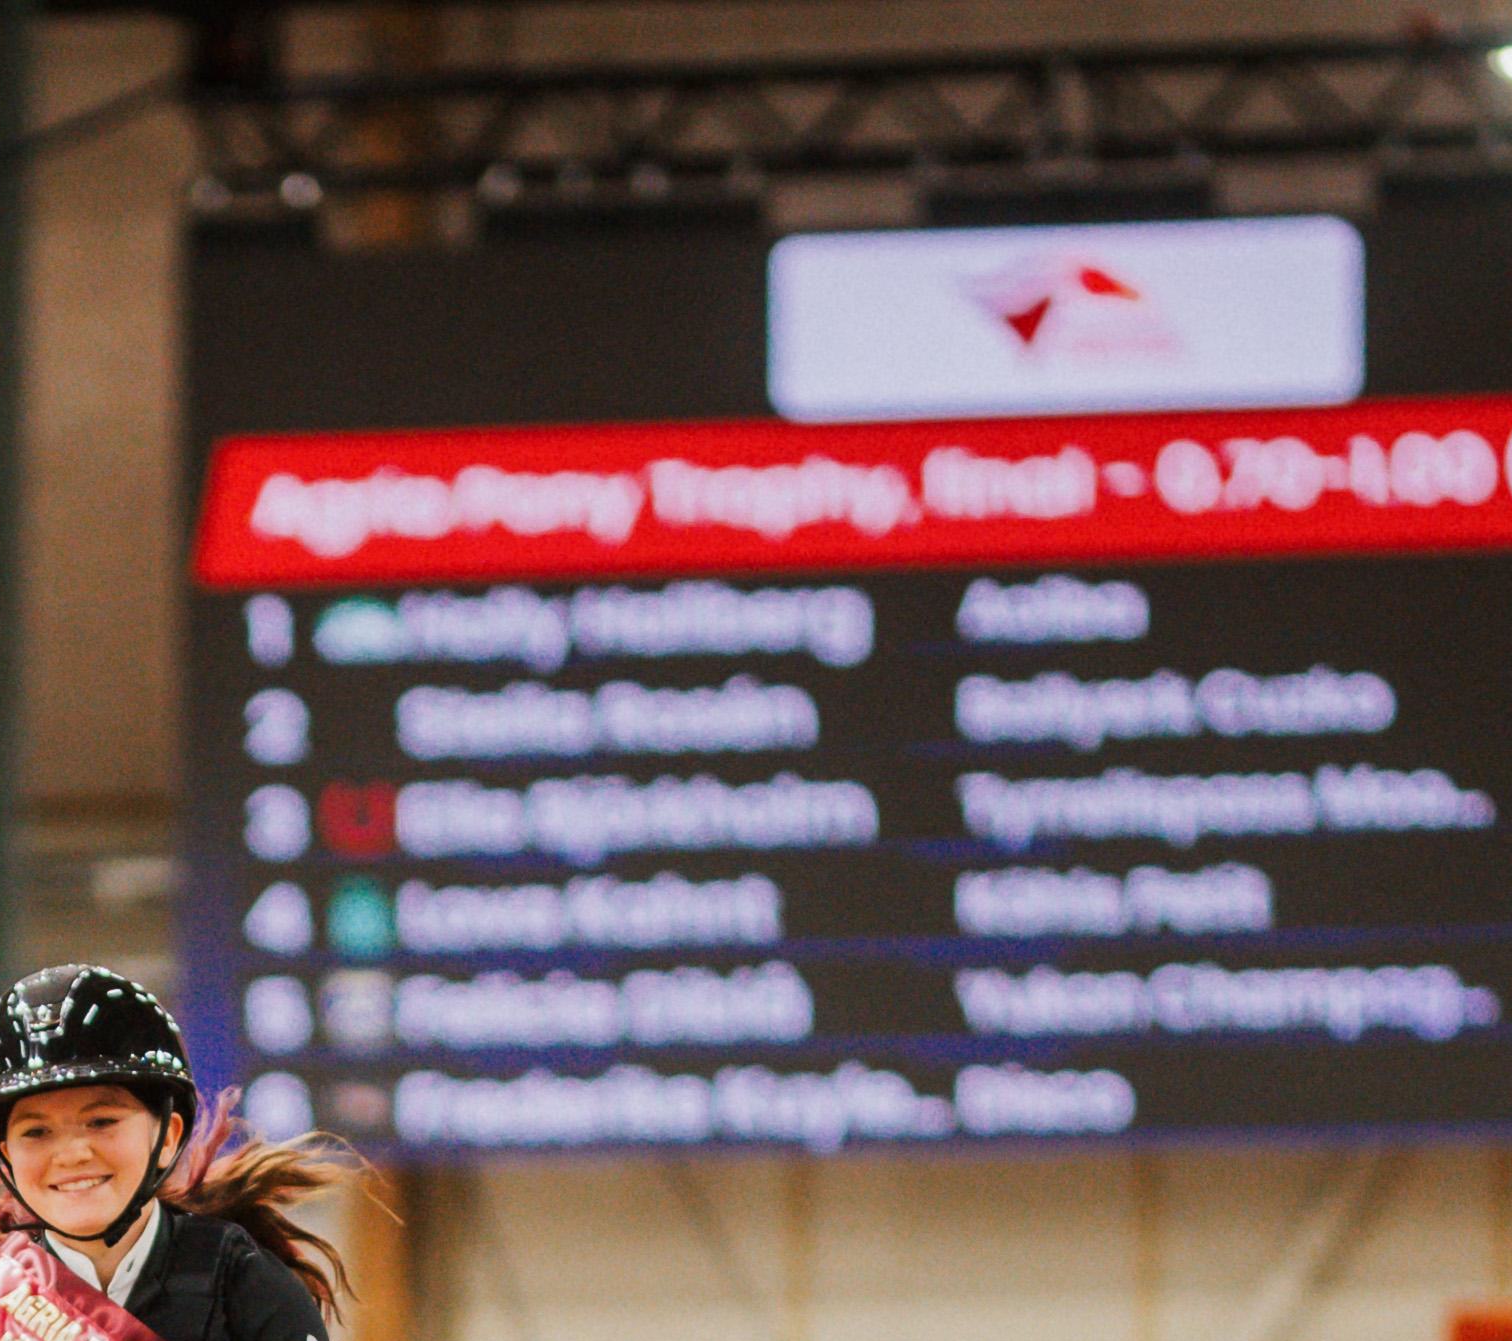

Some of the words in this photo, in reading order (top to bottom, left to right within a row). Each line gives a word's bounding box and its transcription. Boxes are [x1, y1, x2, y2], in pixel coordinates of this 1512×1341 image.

[252, 599, 289, 655] 1
[250, 692, 306, 760] 2
[249, 886, 308, 949] 4
